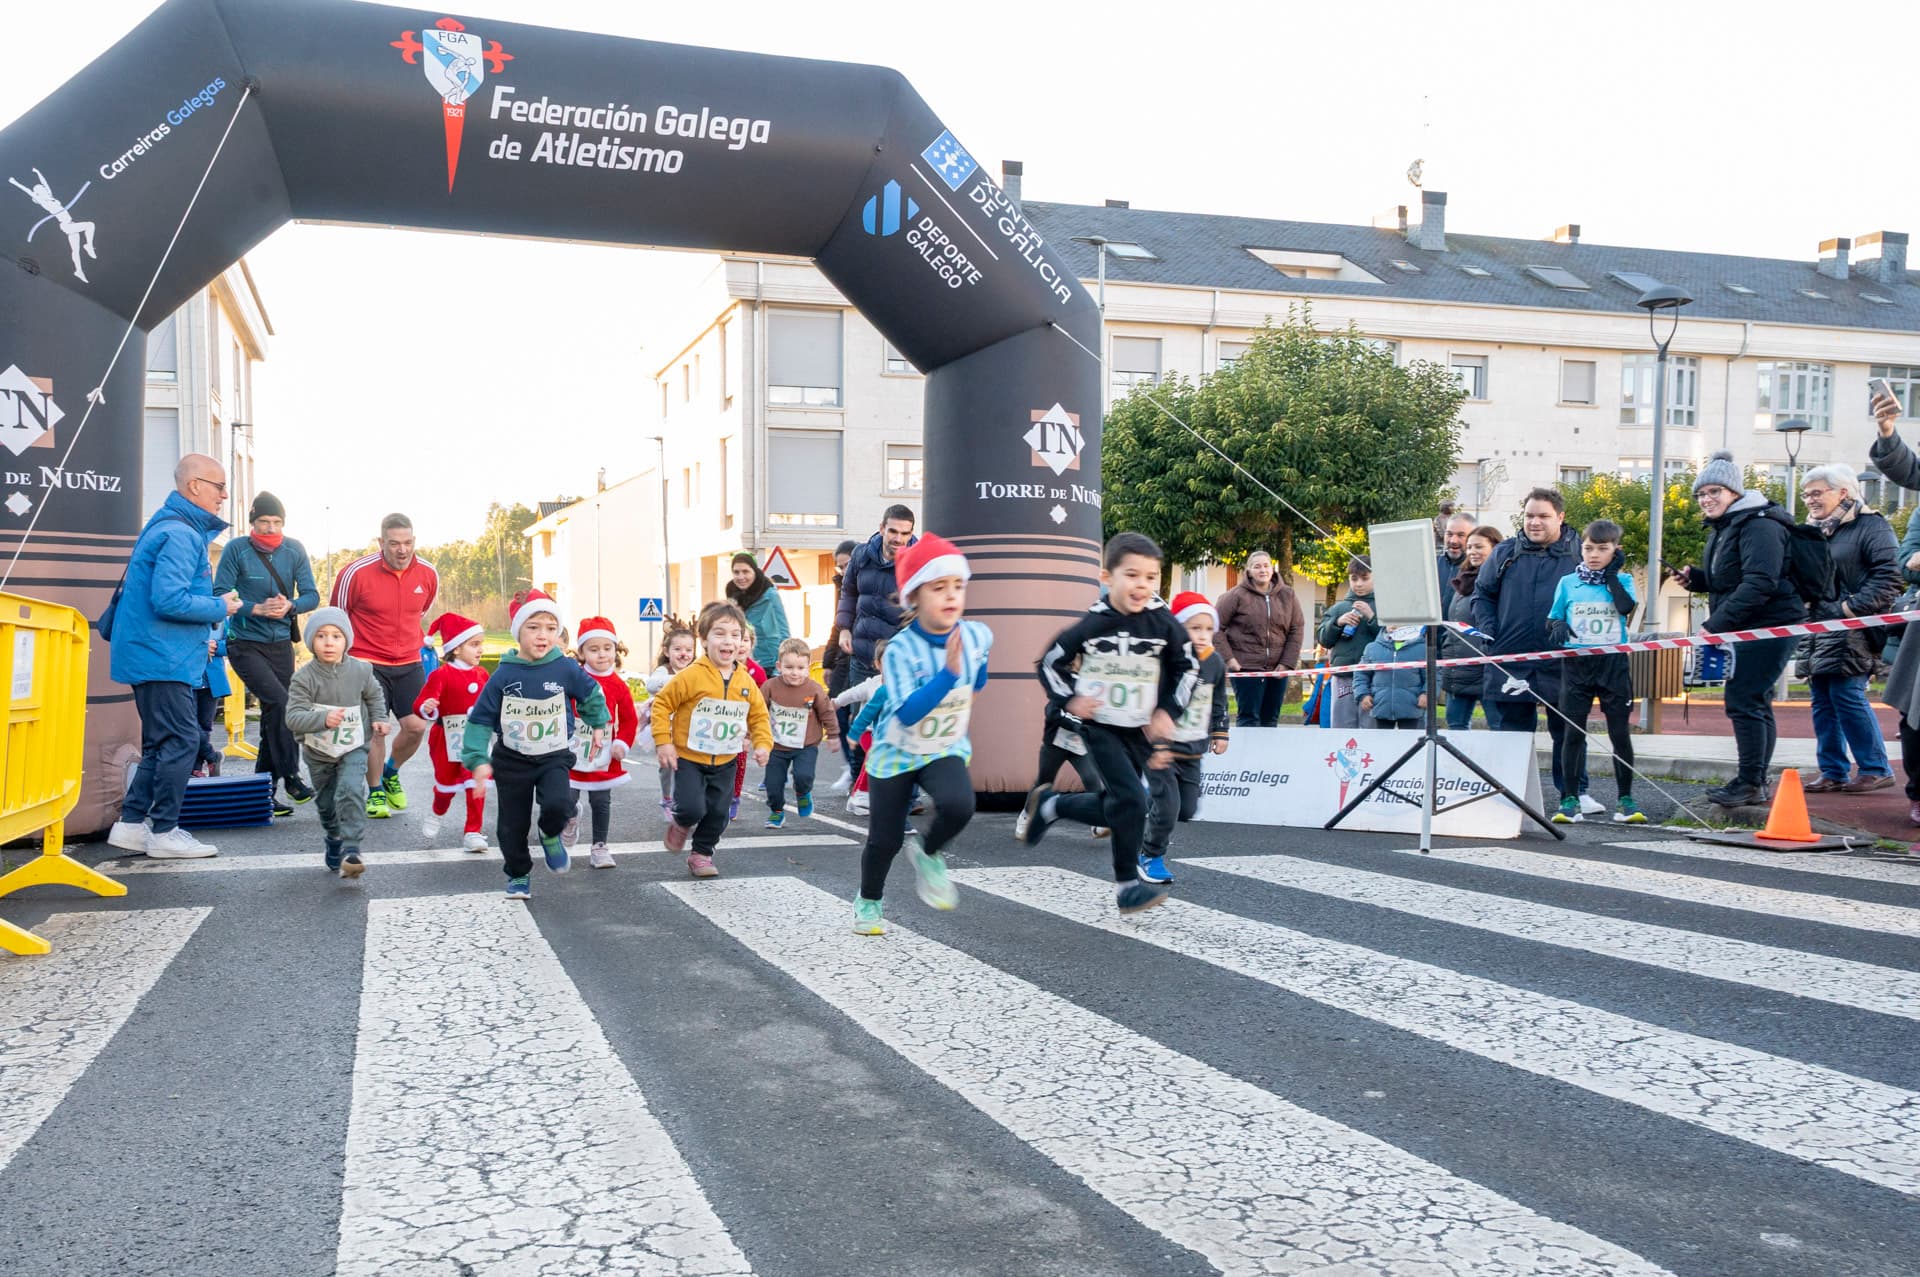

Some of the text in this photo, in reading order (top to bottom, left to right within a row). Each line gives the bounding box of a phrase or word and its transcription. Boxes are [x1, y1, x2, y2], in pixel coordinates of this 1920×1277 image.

[438, 31, 468, 44] FGA
[446, 107, 464, 117] 1921
[490, 85, 771, 151] Federación Galega
[100, 77, 226, 180] Carreiras Galegas
[488, 132, 684, 174] de Atletismo
[980, 176, 1044, 248] XUNTA
[917, 216, 983, 285] DEPORTE
[968, 185, 1072, 305] DE GALICIA
[906, 229, 963, 289] GALEGO
[1029, 421, 1080, 456] TN
[5, 471, 32, 486] DE
[976, 481, 1046, 499] TORRE
[1050, 488, 1068, 499] DE
[1575, 618, 1614, 635] 407
[1086, 680, 1144, 710] 201
[507, 717, 561, 742] 204
[695, 717, 743, 742] 209
[1199, 770, 1290, 788] eración Galega
[1199, 782, 1250, 797] tletismo
